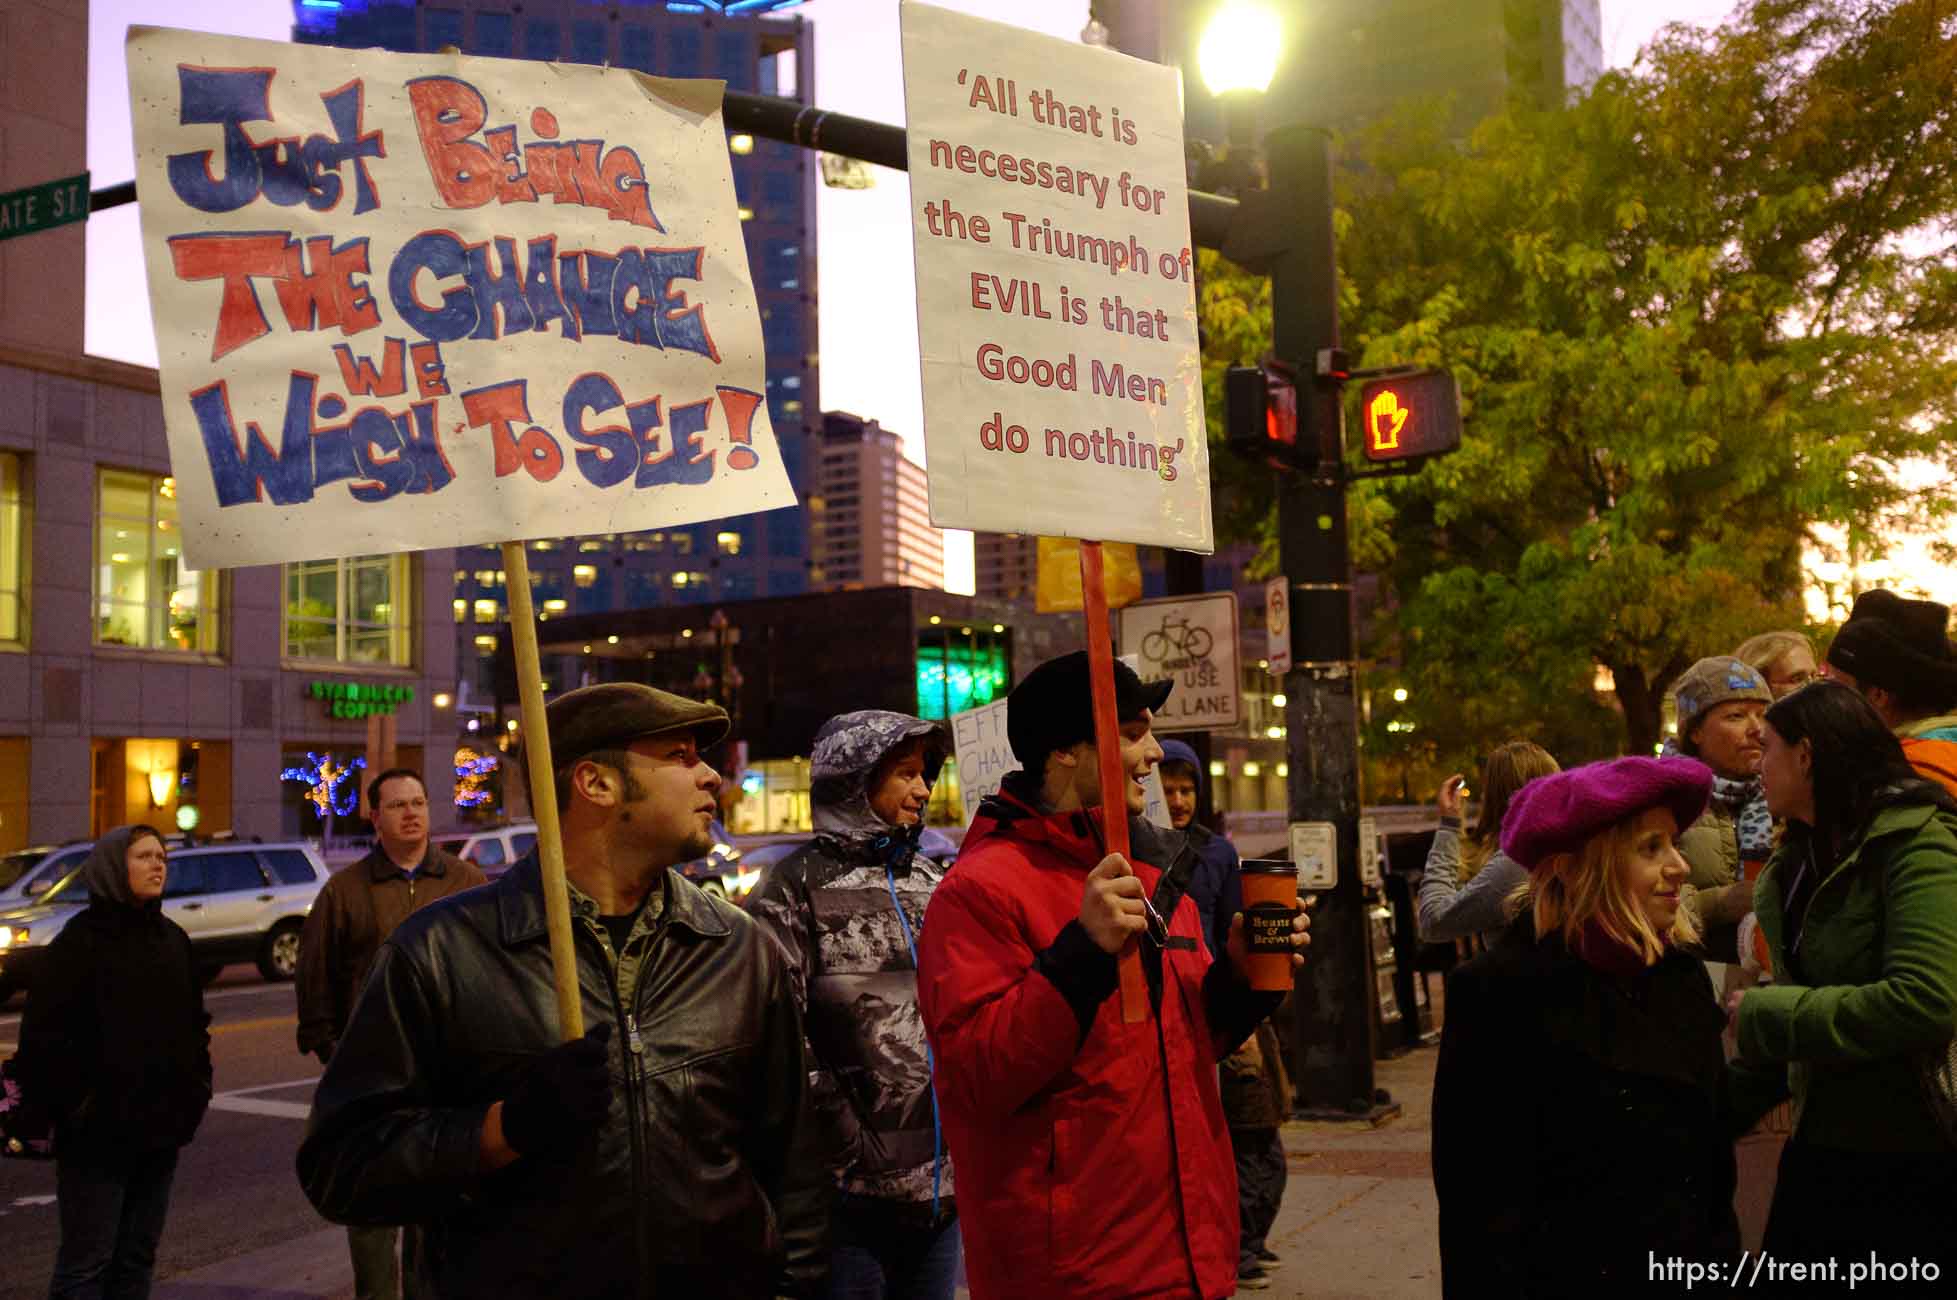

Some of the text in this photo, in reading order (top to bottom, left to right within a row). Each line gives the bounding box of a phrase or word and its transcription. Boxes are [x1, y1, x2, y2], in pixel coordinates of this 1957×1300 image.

[167, 63, 387, 215] Just
[1029, 89, 1103, 138] that
[1112, 107, 1138, 146] is
[929, 139, 1166, 215] necessary for
[924, 200, 1191, 282] the Triumph of
[167, 228, 721, 364] THE CHANGE
[971, 272, 1169, 341] EVIL is that
[332, 336, 451, 399] WE
[976, 343, 1168, 406] Good Men
[980, 412, 1029, 454] do
[1182, 695, 1232, 716] LANE
[1184, 671, 1219, 688] USE
